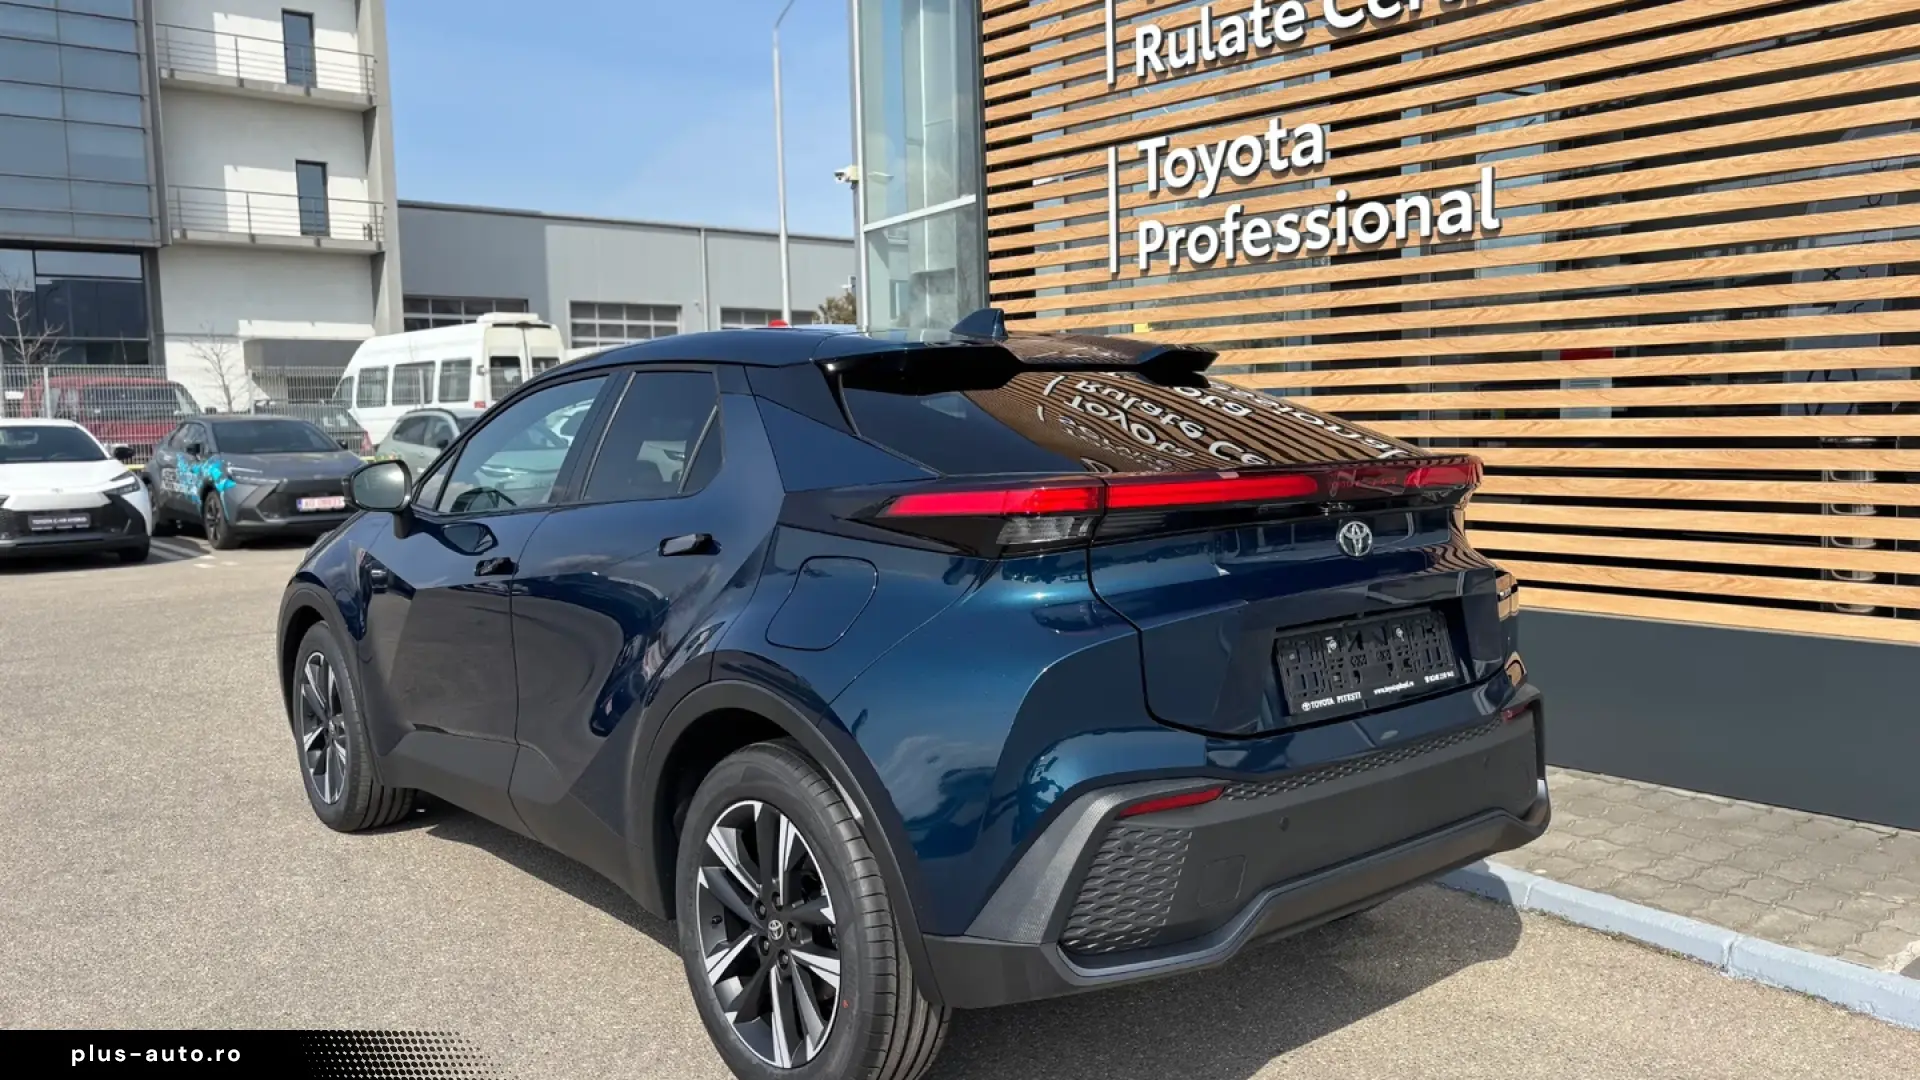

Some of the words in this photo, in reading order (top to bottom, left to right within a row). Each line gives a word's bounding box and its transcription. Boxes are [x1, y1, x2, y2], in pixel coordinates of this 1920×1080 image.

[1136, 0, 1304, 77] Rulate
[1138, 117, 1327, 199] Toyota
[1139, 166, 1500, 270] Professional
[1311, 697, 1335, 709] TOYOTA
